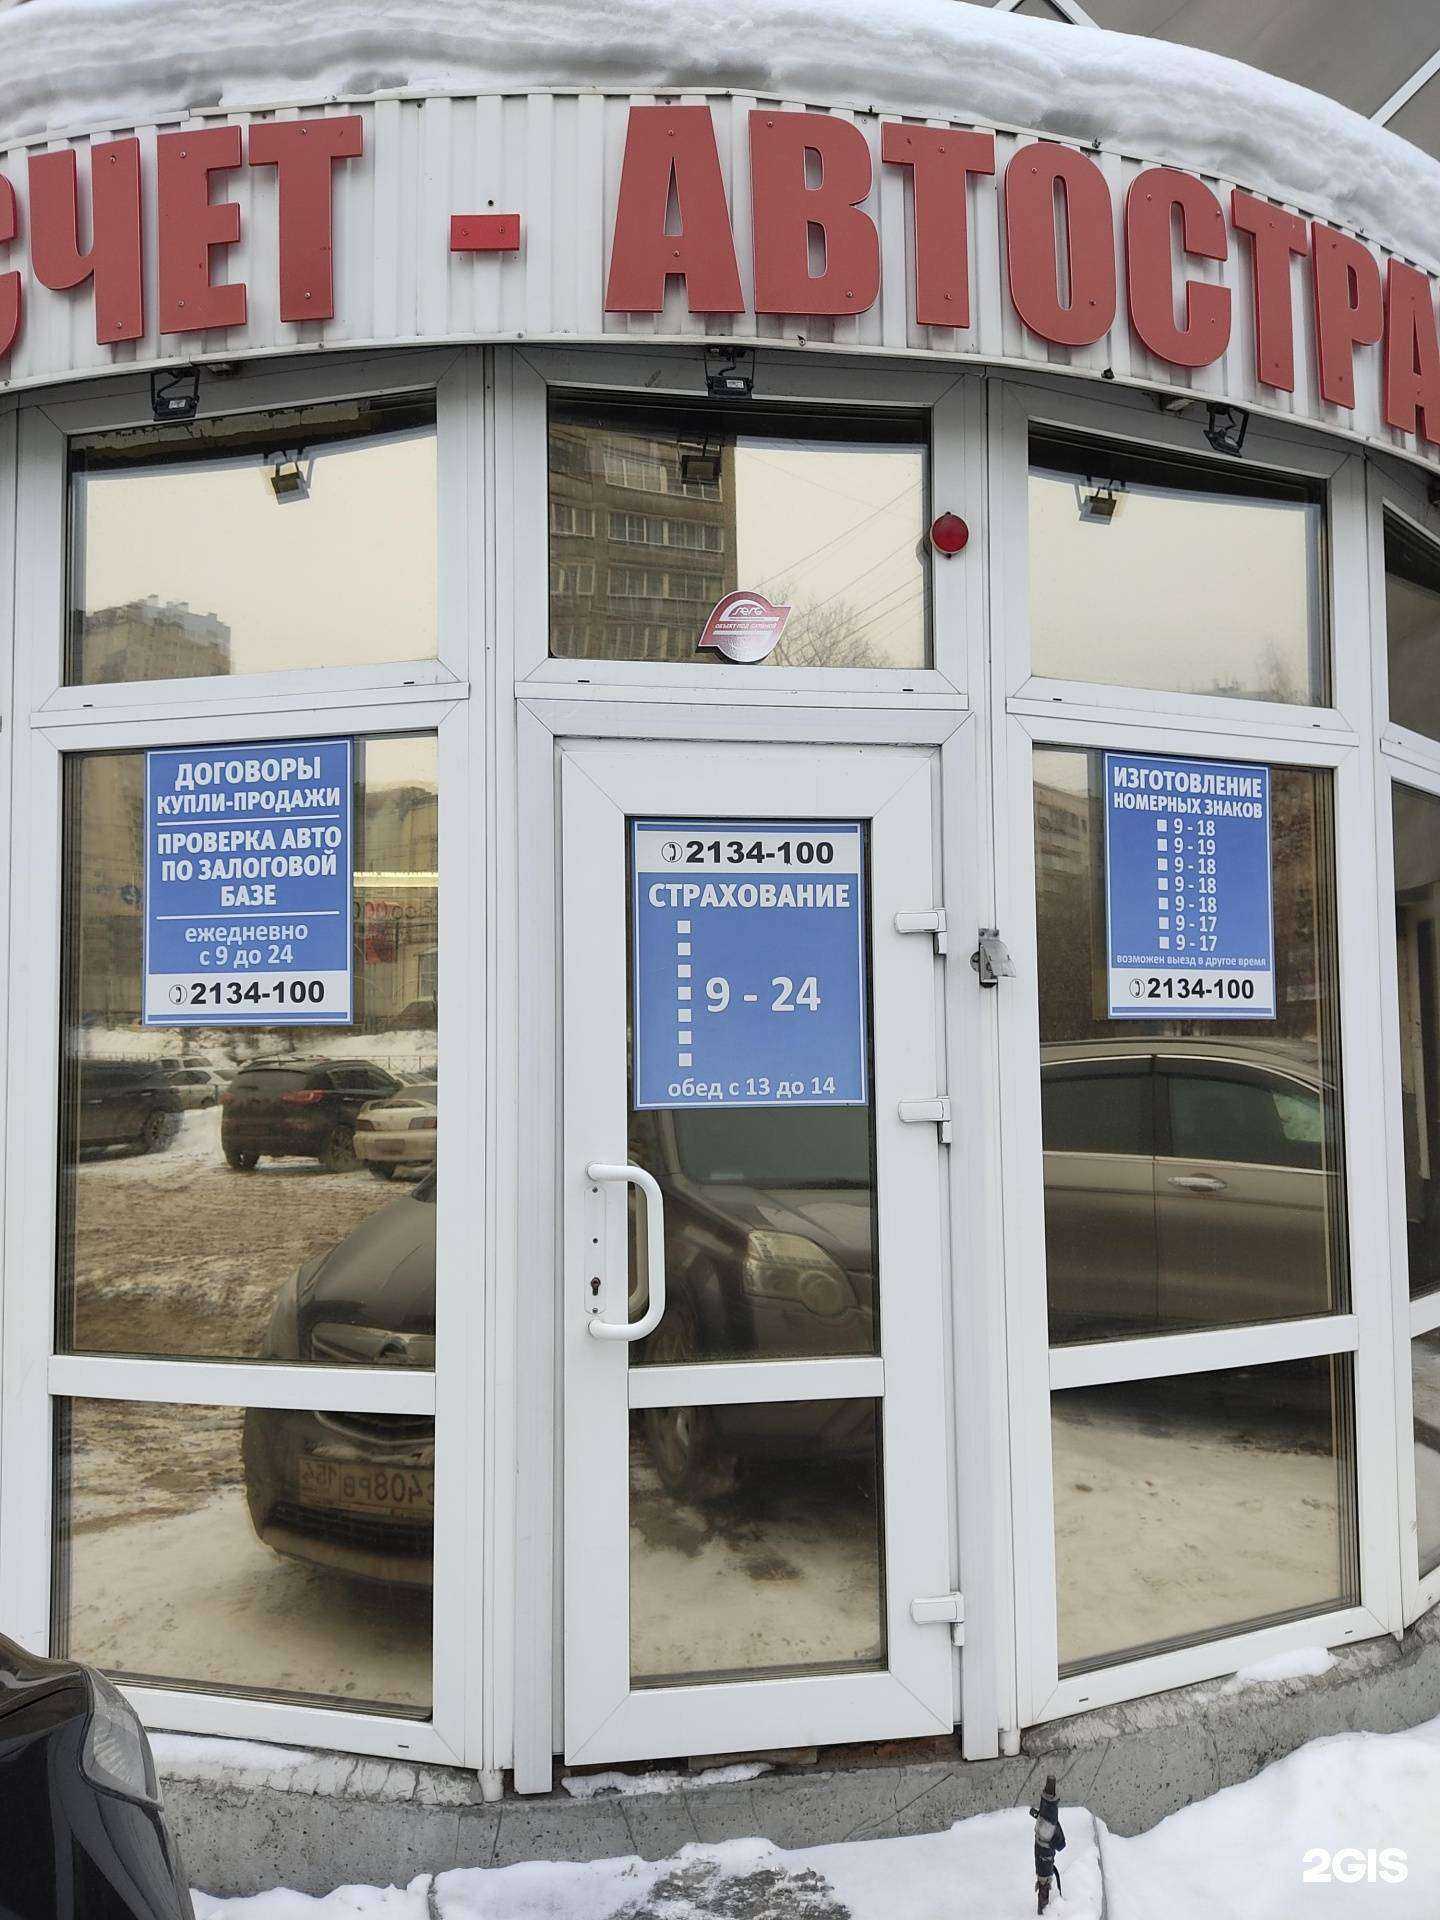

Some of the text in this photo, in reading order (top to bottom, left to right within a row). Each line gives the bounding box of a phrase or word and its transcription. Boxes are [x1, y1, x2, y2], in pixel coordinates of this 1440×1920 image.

[0, 114, 363, 360] ЧЕТ
[604, 105, 1440, 446] АВТОСТРА
[175, 757, 321, 791] ДОГОВОРЫ
[1114, 766, 1263, 798] ИЗГОТОВЛЕНИЕ
[157, 787, 340, 815] КУПЛИ-ПРОДАЖИ
[1114, 792, 1263, 819] НОМЕРНЫХ ЗНАКОВ
[157, 826, 342, 855] ПРОВЕРКА АВТО
[686, 841, 834, 865] 2134-100
[161, 849, 337, 881] ПО ЗАЛОГОВОЙ
[221, 885, 277, 907] БАЗЕ
[648, 883, 850, 908] СТРАХОВАНИЕ
[184, 923, 308, 946] ежедневно
[199, 944, 294, 968] с 9 до 24
[1116, 954, 1266, 968] возможен выезд в другое время
[190, 980, 325, 1005] 2134-100
[1147, 977, 1254, 999] 2134-100
[668, 1076, 836, 1100] обед с 13 до 14
